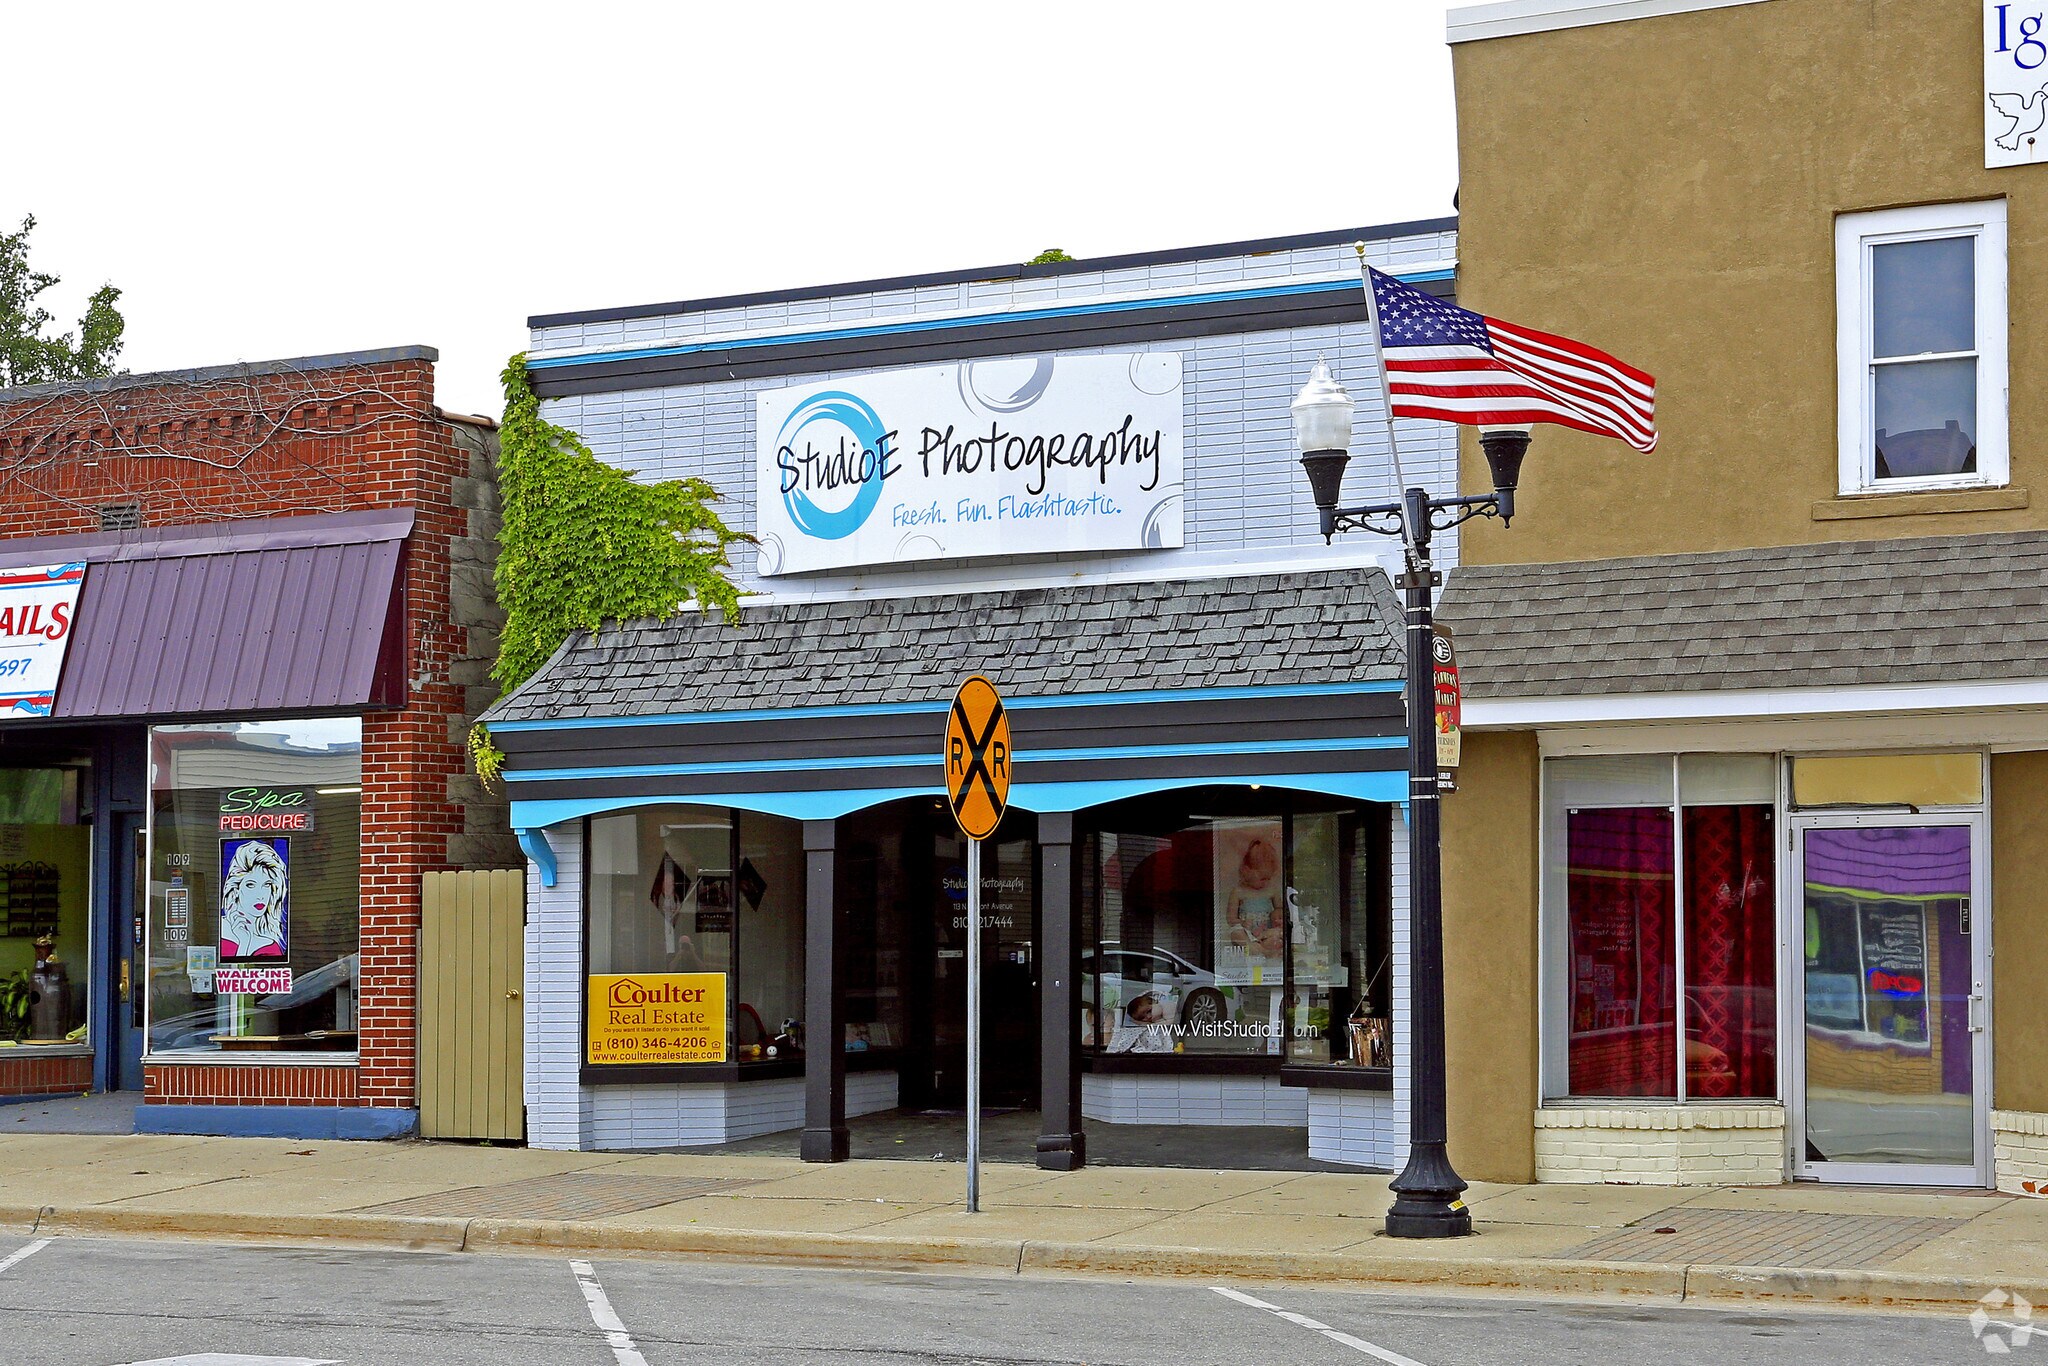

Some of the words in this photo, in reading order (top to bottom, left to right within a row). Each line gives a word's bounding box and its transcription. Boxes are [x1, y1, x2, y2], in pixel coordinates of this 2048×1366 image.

[776, 430, 901, 494] StudioE
[918, 414, 1161, 496] Photography
[892, 500, 947, 528] Fresh.
[956, 496, 993, 521] Fun.
[998, 492, 1121, 520] Flashtastic.
[220, 788, 306, 812] Spa
[220, 814, 305, 831] PEDICURE
[167, 854, 190, 866] 109
[164, 929, 187, 941] 109
[218, 979, 291, 992] WELCOME
[614, 983, 705, 1004] Coulter
[609, 1009, 646, 1024] Real
[652, 1009, 705, 1024] Estate
[607, 1038, 639, 1050] (810)
[642, 1037, 707, 1049] 346-4206
[593, 1051, 721, 1060] www.coulterrealestate.com
